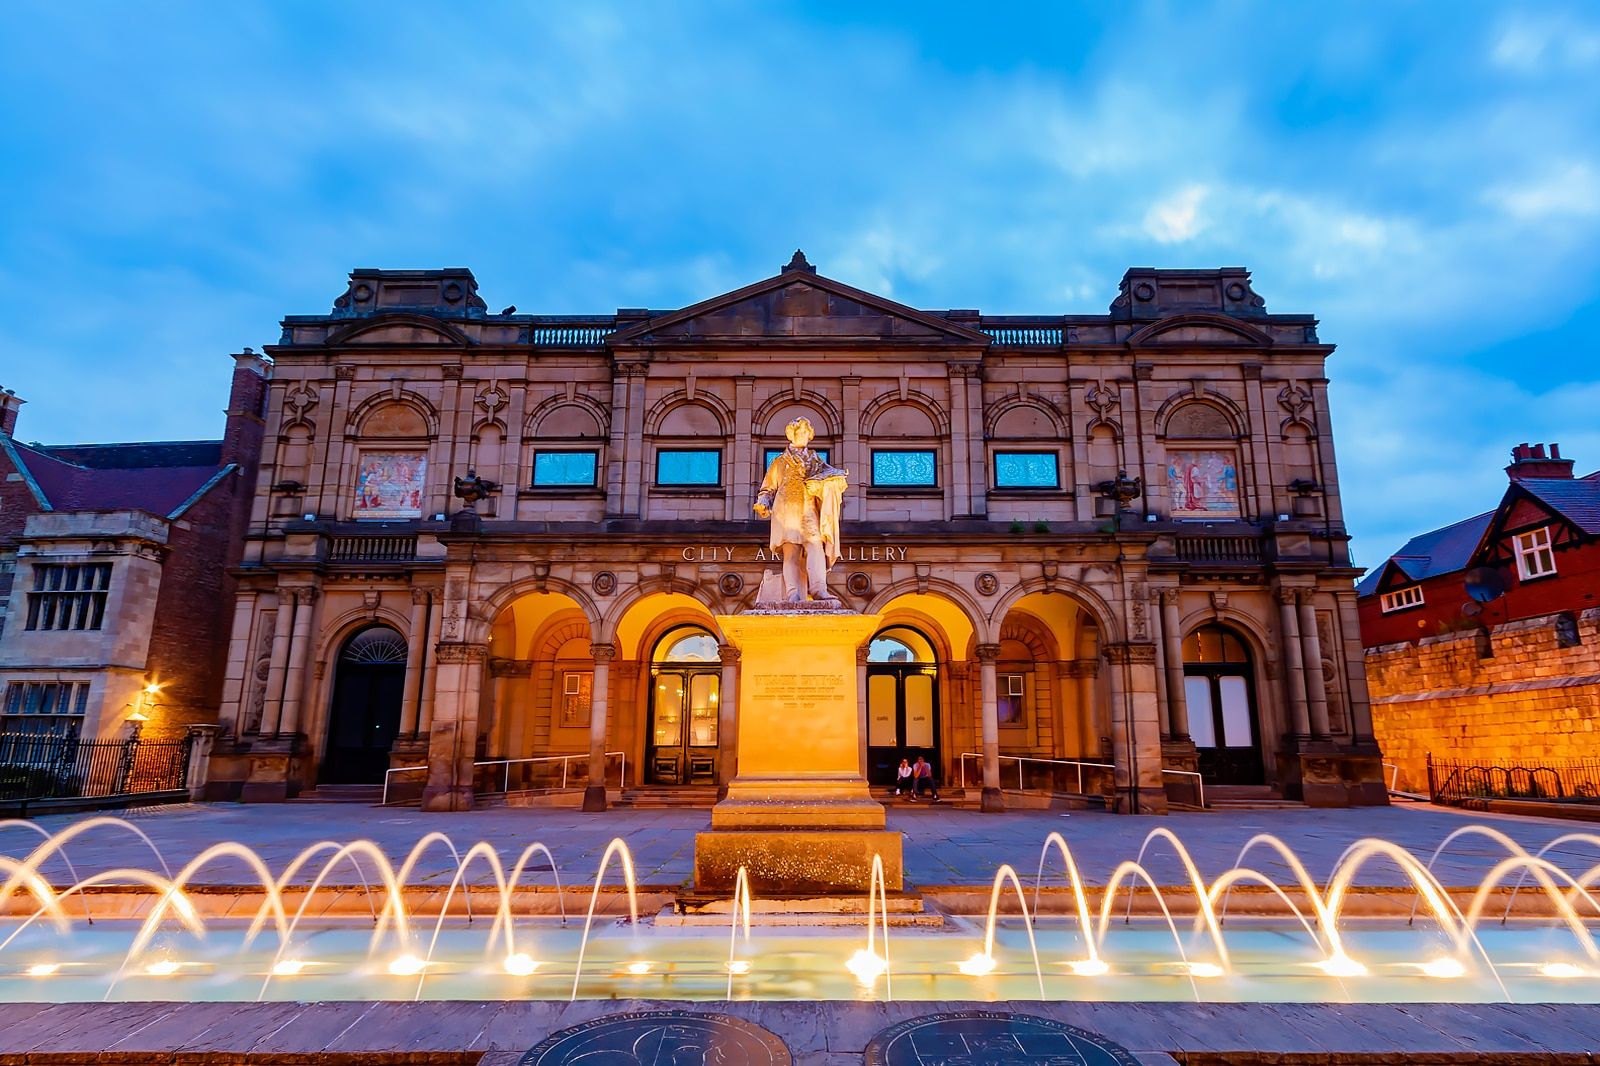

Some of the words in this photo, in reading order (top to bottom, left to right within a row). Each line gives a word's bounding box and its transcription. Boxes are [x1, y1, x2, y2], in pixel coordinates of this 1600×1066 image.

[682, 546, 736, 561] CITY
[754, 546, 782, 561] AR
[838, 546, 908, 561] LLERY
